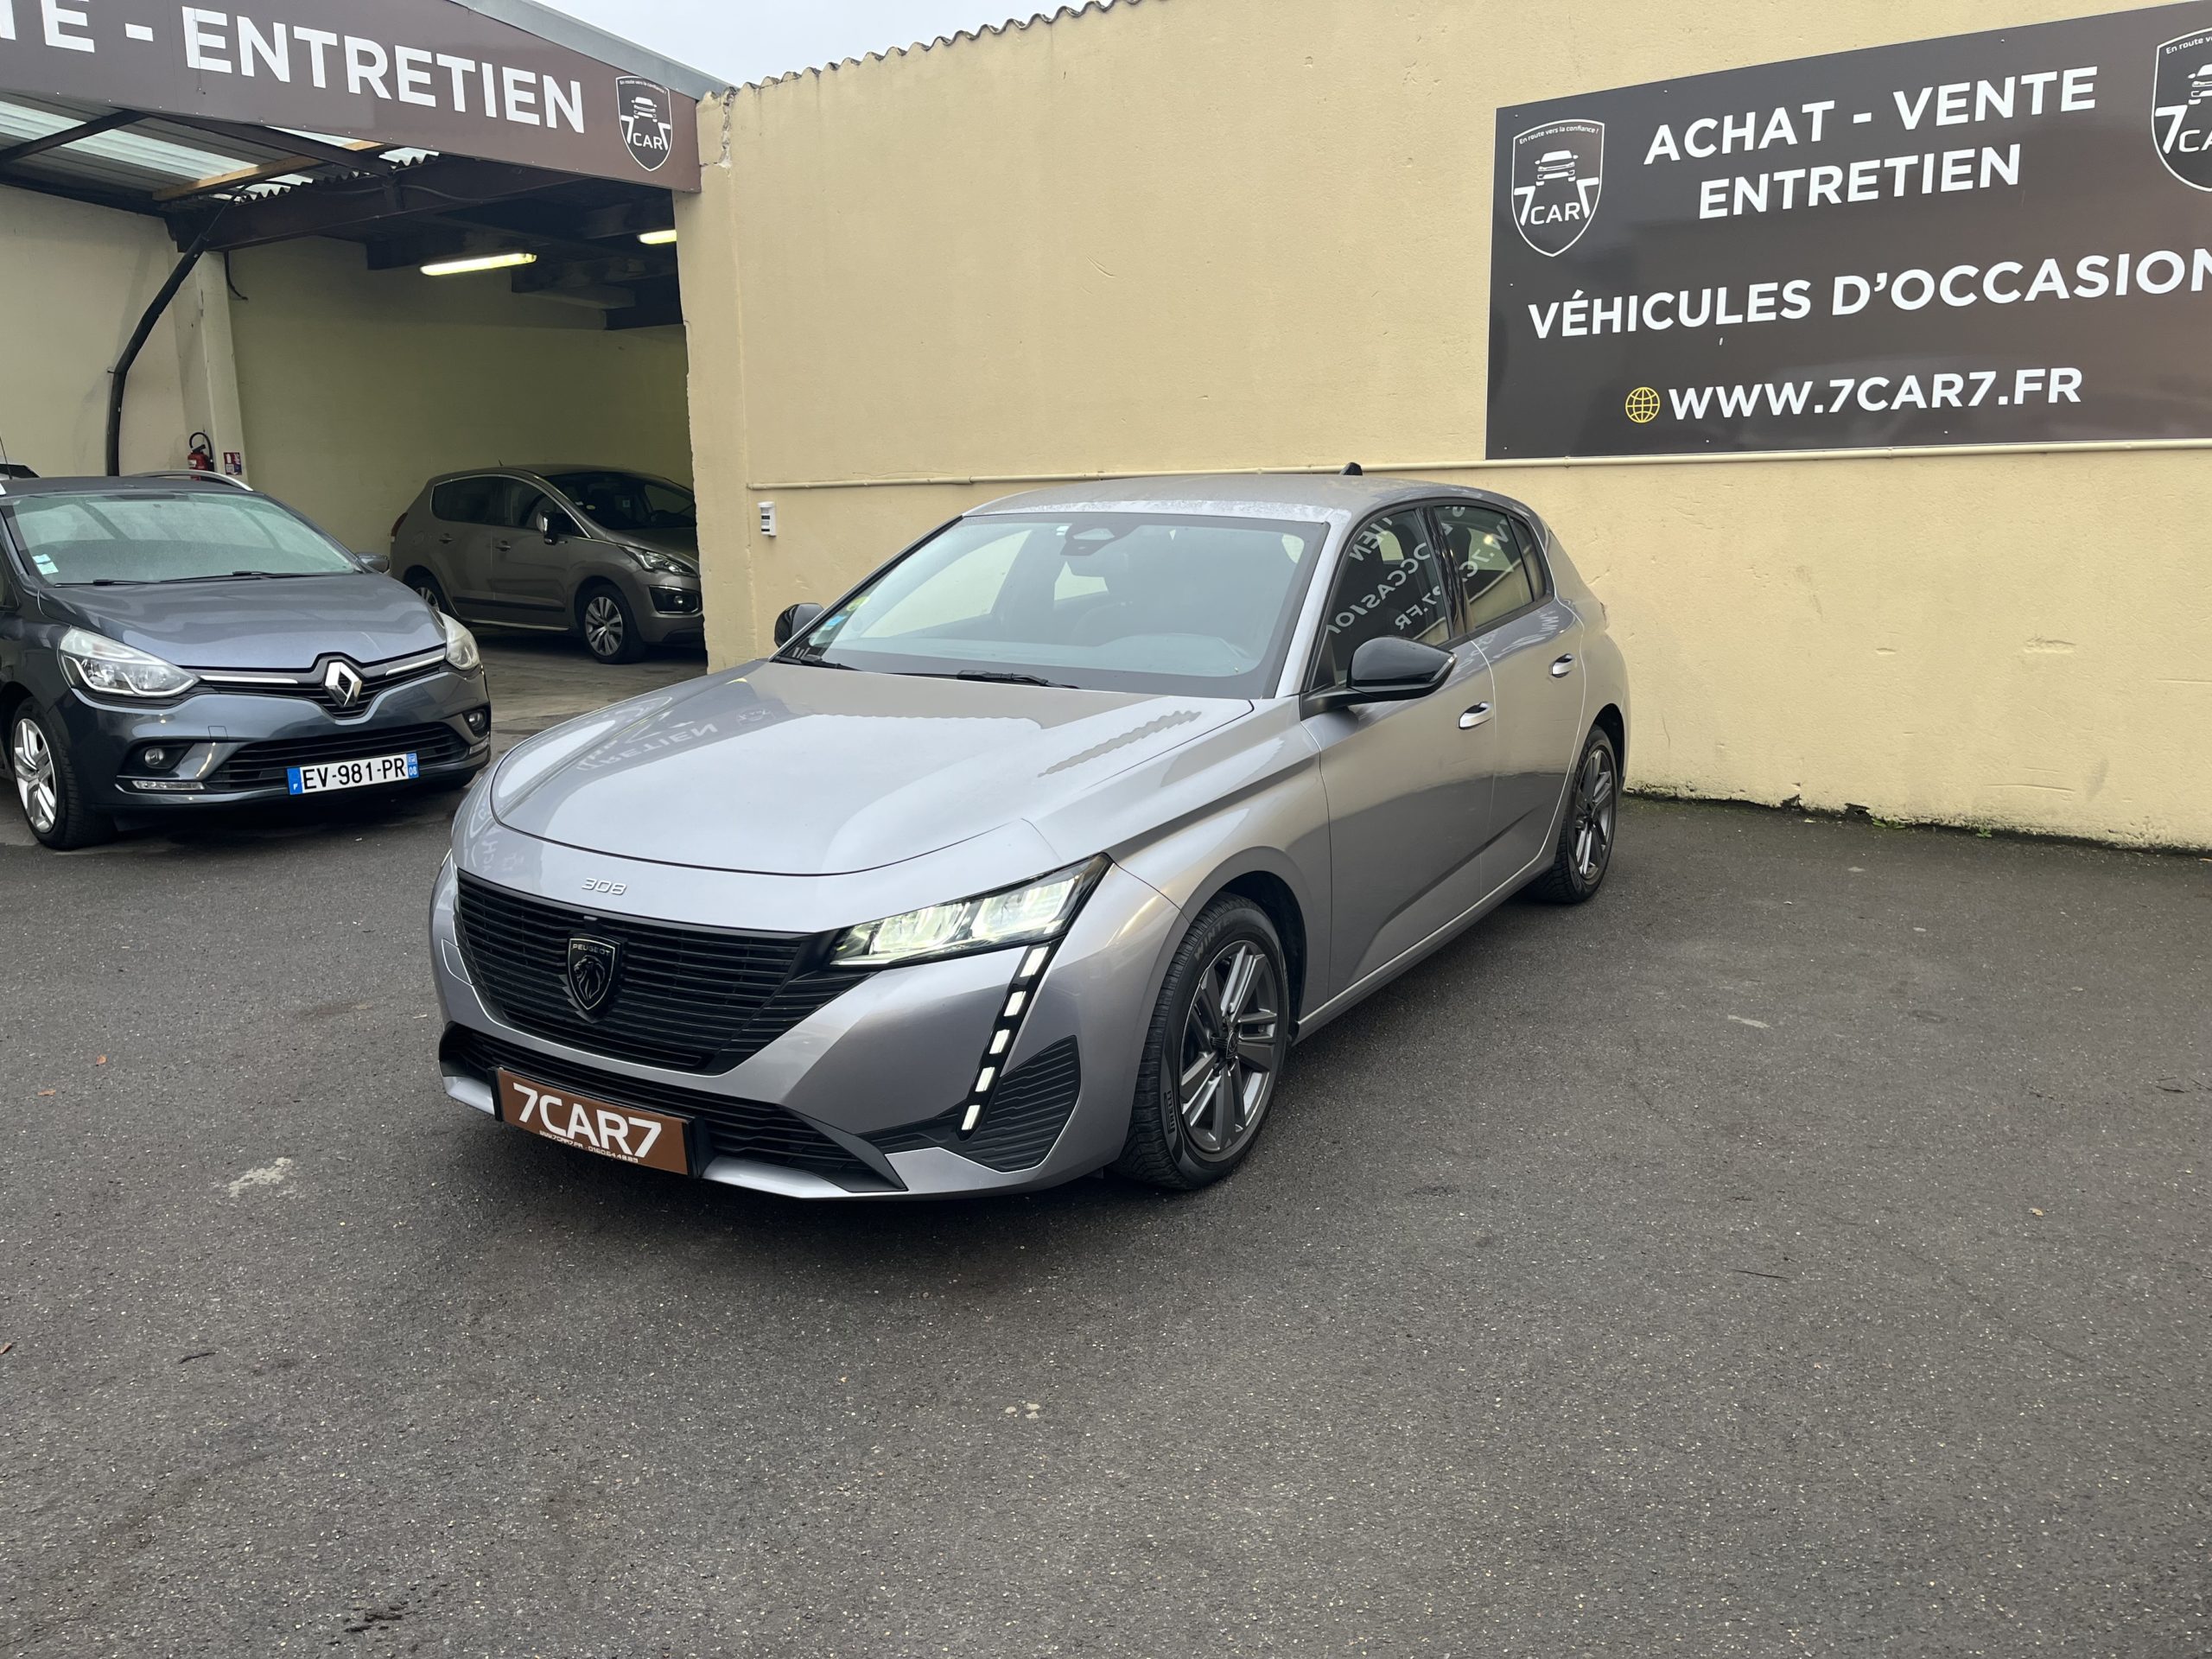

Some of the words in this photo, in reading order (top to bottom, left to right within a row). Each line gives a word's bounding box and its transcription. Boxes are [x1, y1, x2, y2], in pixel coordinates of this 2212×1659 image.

[182, 6, 585, 134] ENTRETIEN
[2165, 46, 2177, 54] En
[2179, 37, 2203, 50] route
[1528, 130, 1545, 141] route
[1644, 100, 1835, 165] ACHAT
[1892, 67, 2098, 130] VENTE
[1699, 144, 2021, 219] ENTRETIEN
[1529, 280, 1811, 339] VÉHICULES
[1669, 368, 2083, 420] WWW.7CAR7.FR
[302, 758, 406, 790] EV-981-PR
[582, 877, 627, 896] 308
[572, 944, 611, 957] PEUGEOT
[513, 1082, 662, 1158] 7CAR7
